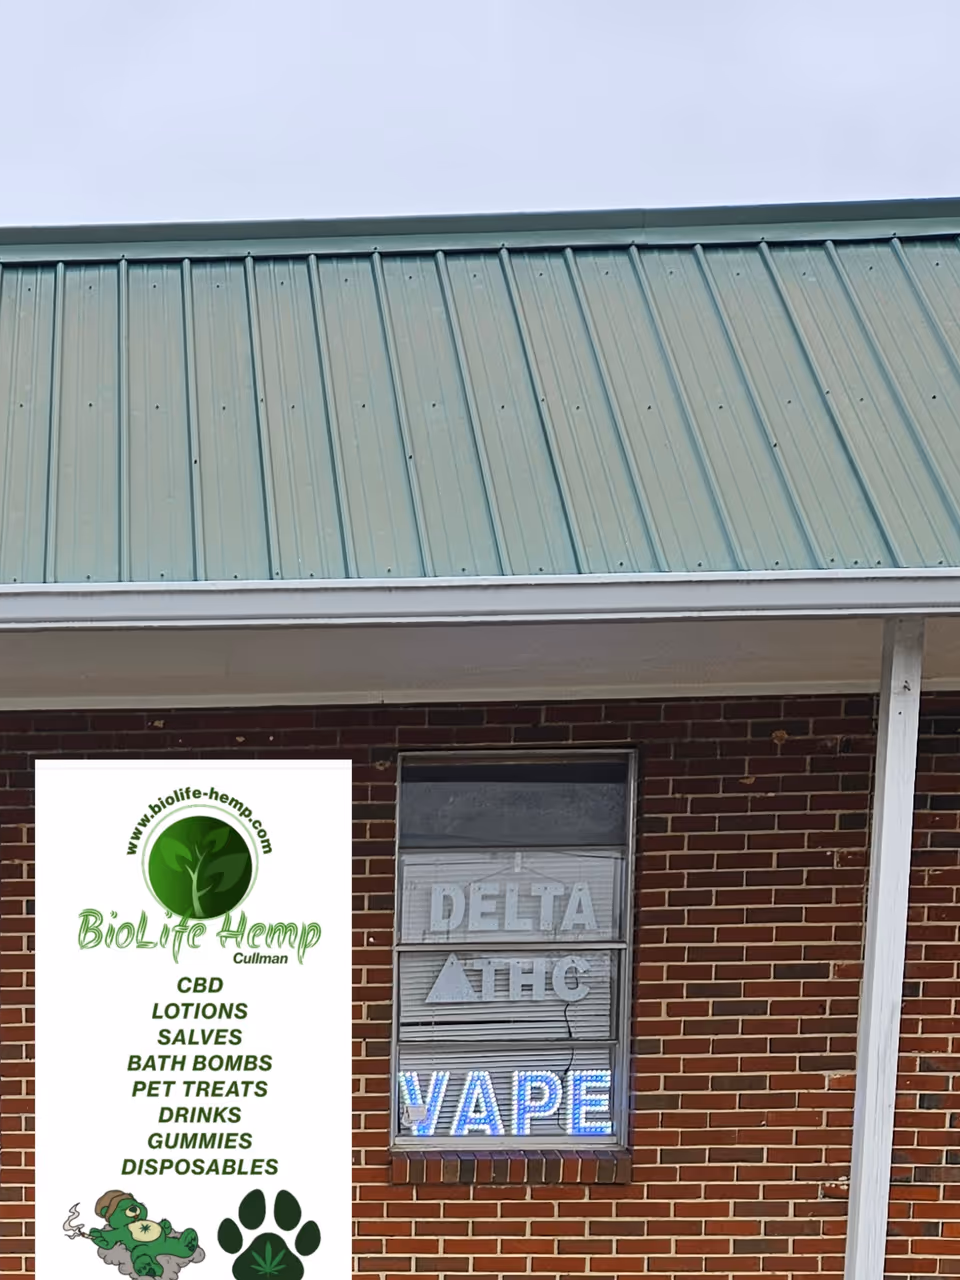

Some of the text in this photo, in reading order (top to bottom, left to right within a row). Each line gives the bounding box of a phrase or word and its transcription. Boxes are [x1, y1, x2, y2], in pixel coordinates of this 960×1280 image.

[126, 786, 273, 856] www.biolife-hemp.com
[429, 881, 599, 932] DELTA
[78, 905, 323, 966] BioLife Hemp
[233, 952, 289, 965] Cullman
[176, 976, 224, 994] CBD
[151, 1002, 248, 1020] LOTIONS
[157, 1028, 243, 1046] SALVES
[127, 1054, 273, 1072] BATH BOMBS
[131, 1080, 268, 1098] PET TREATS
[398, 1069, 615, 1137] VAPE
[158, 1106, 242, 1124] DRINKS
[147, 1132, 253, 1150] GUMMIES
[121, 1158, 279, 1176] DISPOSABLES
